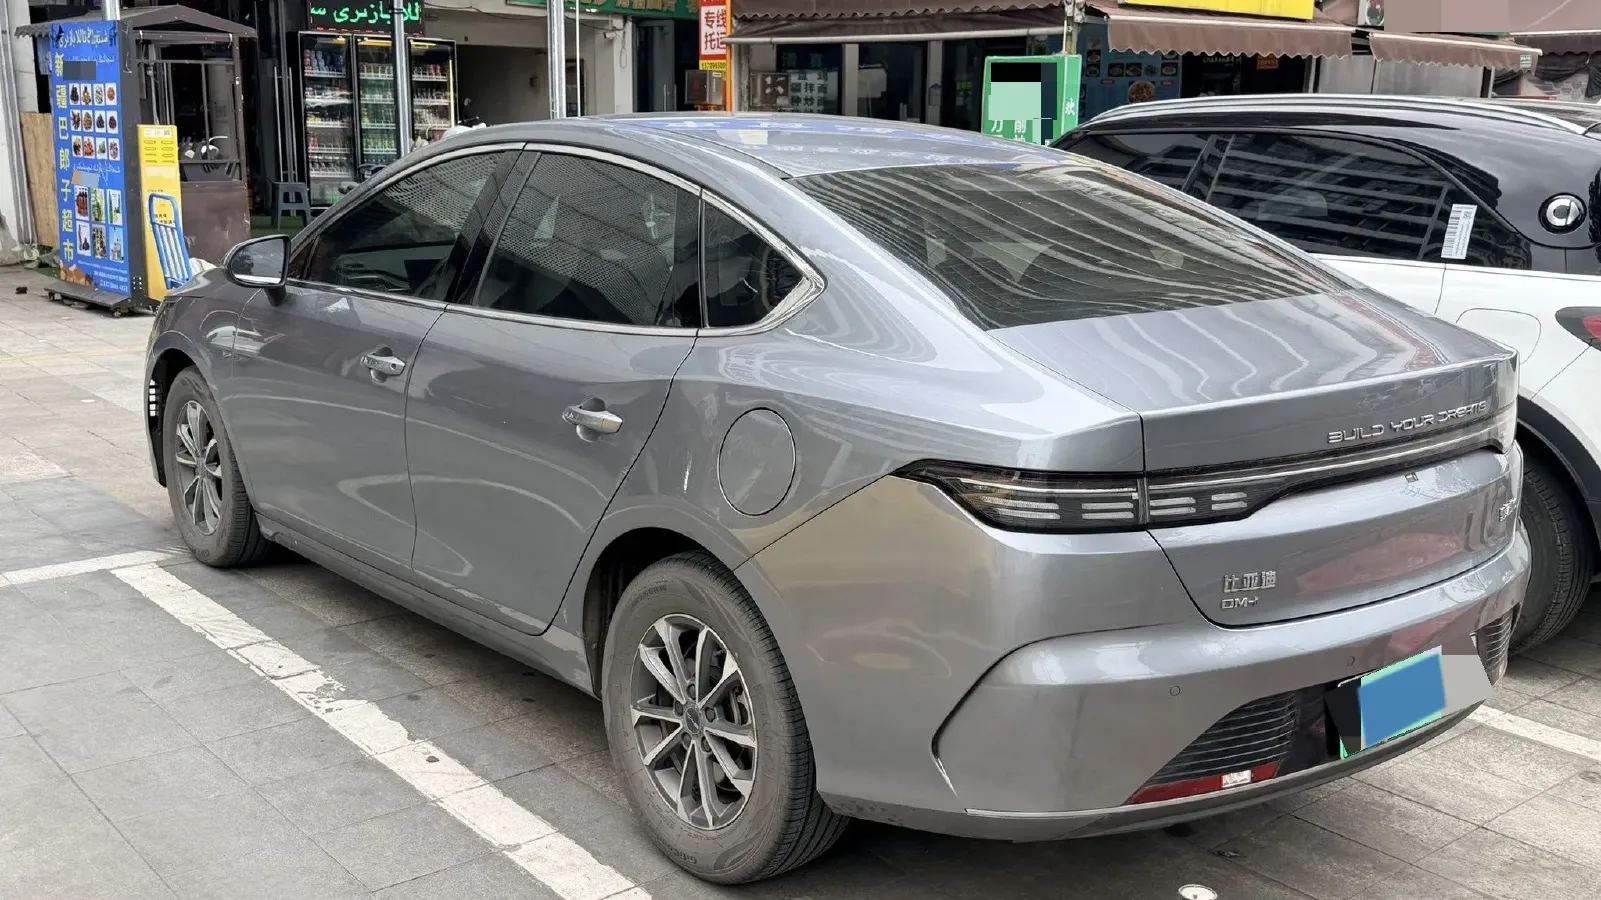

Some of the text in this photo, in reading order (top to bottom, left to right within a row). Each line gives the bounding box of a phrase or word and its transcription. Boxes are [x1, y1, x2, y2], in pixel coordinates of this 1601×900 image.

[1327, 400, 1488, 444] BUILD YOUR DREAMS
[1223, 570, 1277, 593] 比亚迪
